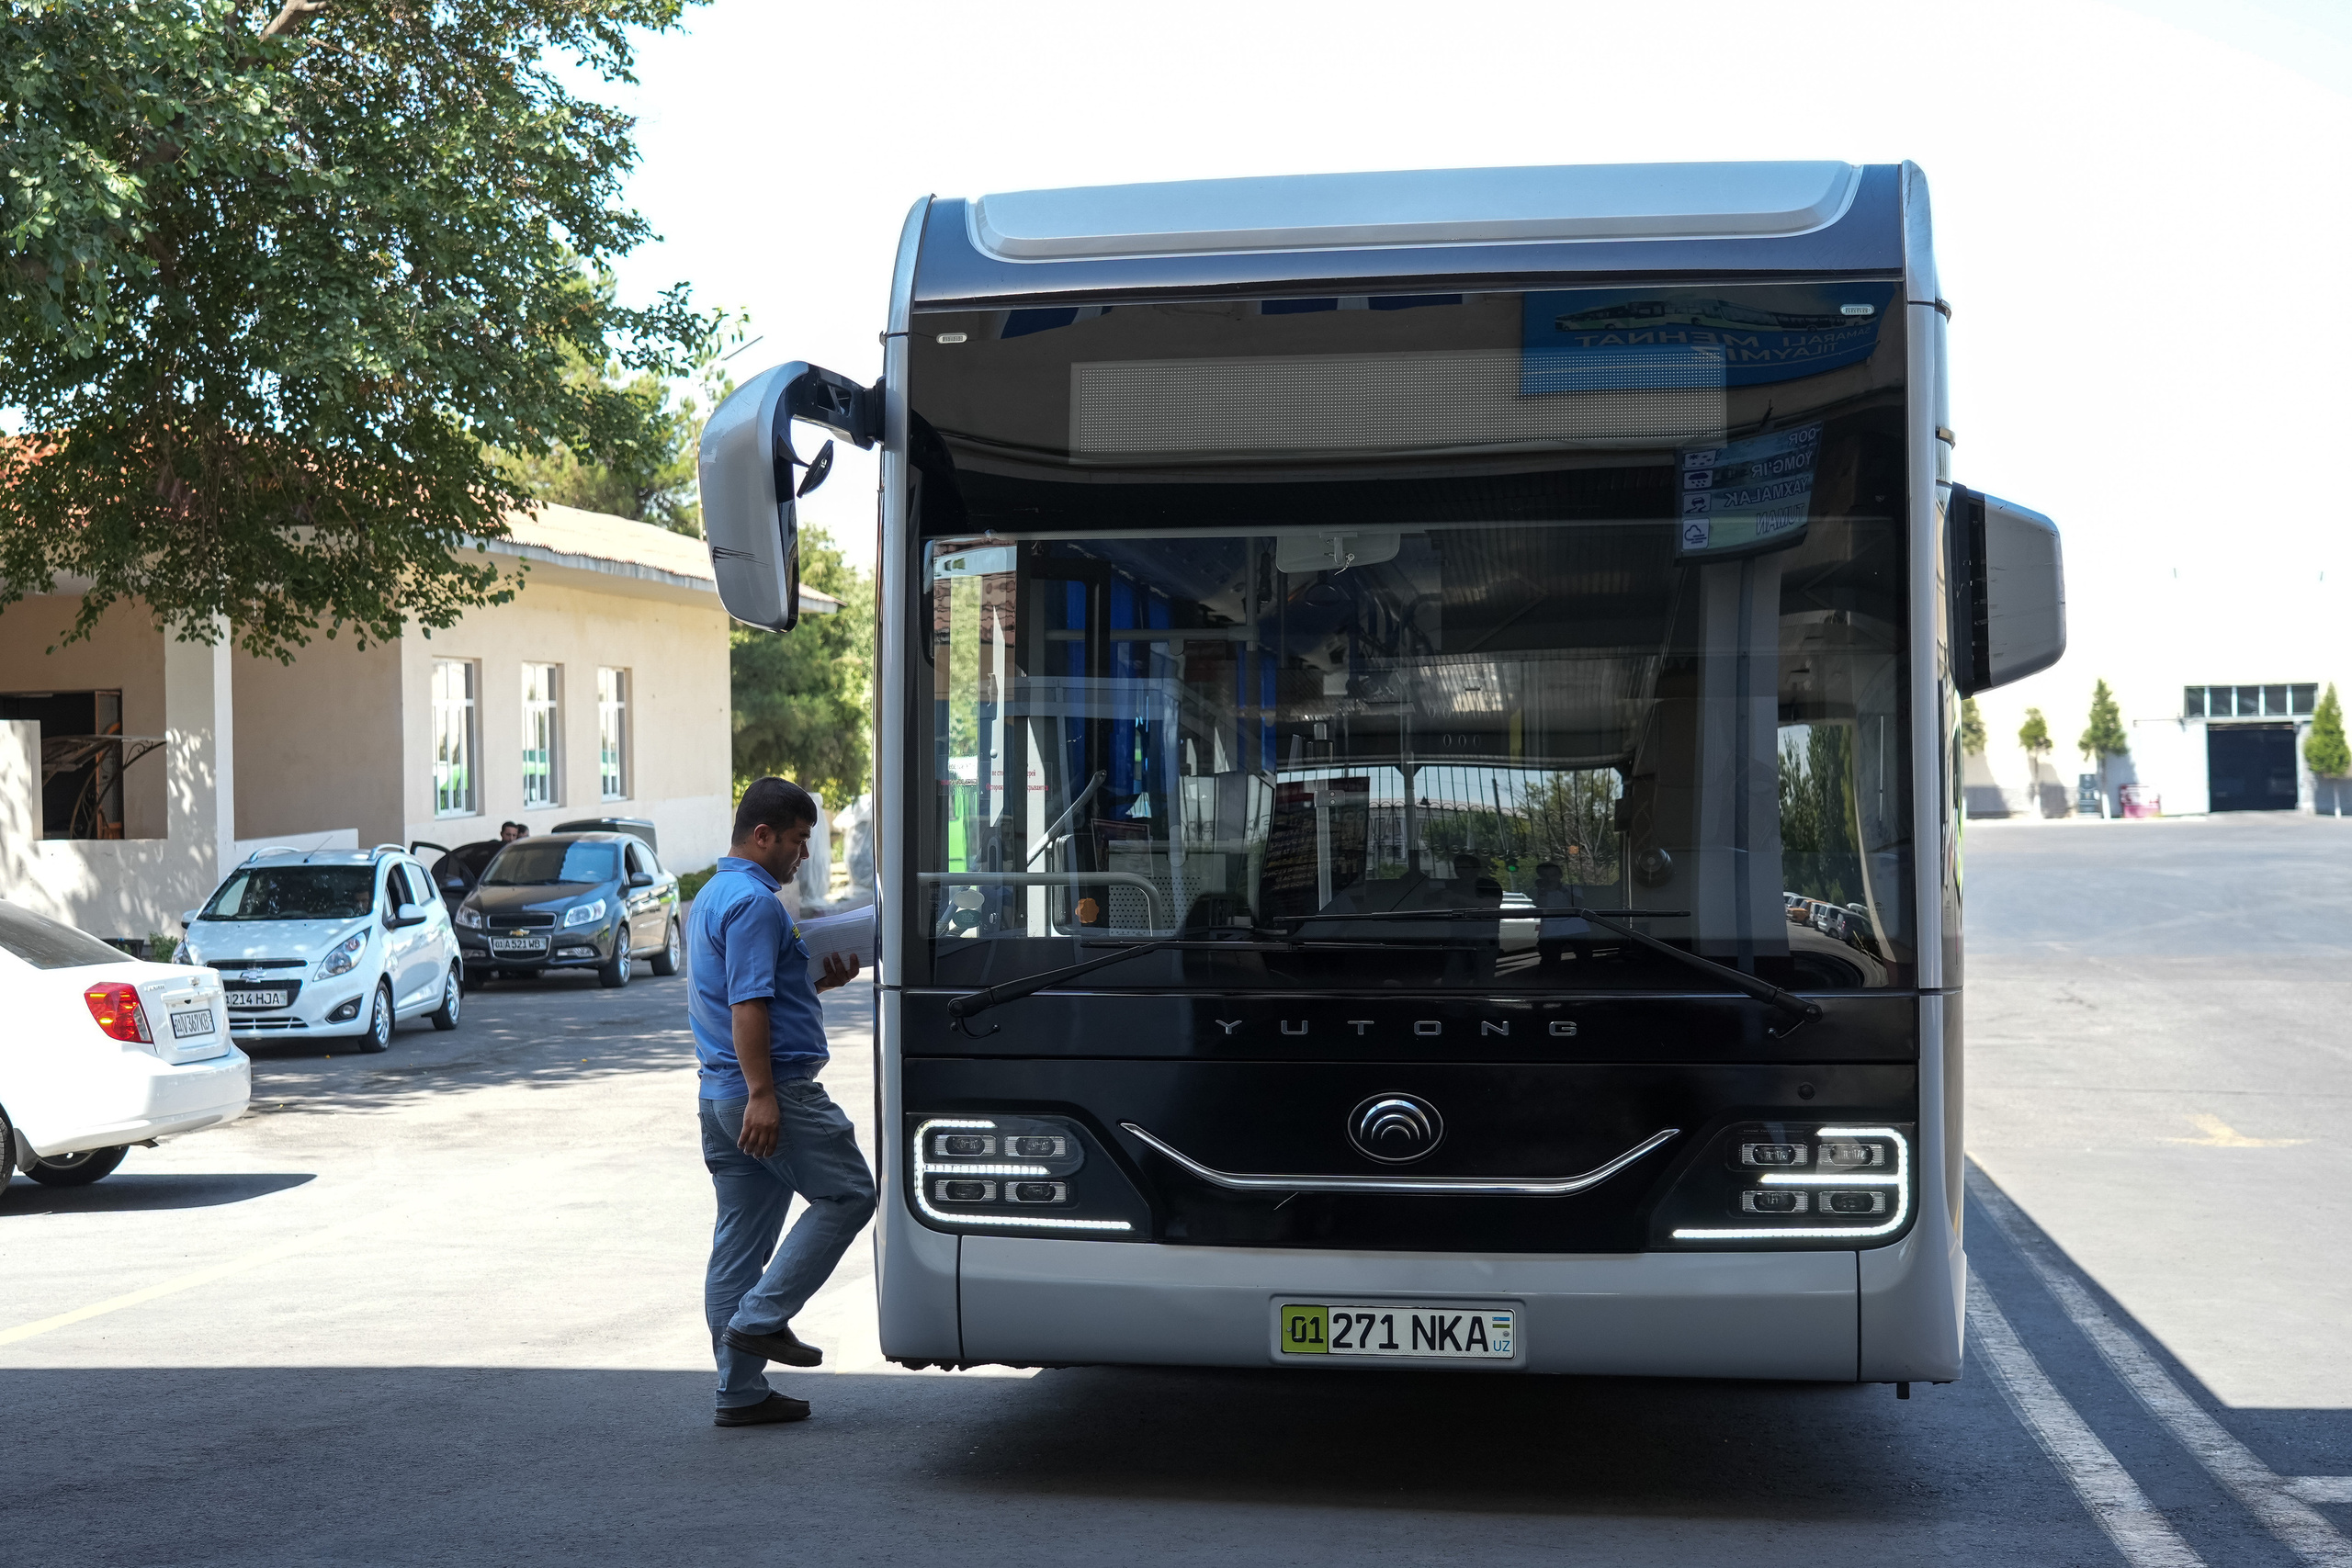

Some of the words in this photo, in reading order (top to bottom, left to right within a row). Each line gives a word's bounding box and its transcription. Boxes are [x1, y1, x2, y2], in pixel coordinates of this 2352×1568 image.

[504, 940, 510, 949] A
[511, 940, 527, 949] 521
[232, 993, 253, 1005] 214
[255, 993, 280, 1005] HJA
[1215, 1020, 1577, 1036] YUTONG
[1291, 1314, 1324, 1344] 01
[1332, 1313, 1399, 1349] 271
[1411, 1314, 1489, 1352] NKA
[1493, 1340, 1510, 1352] UZ
